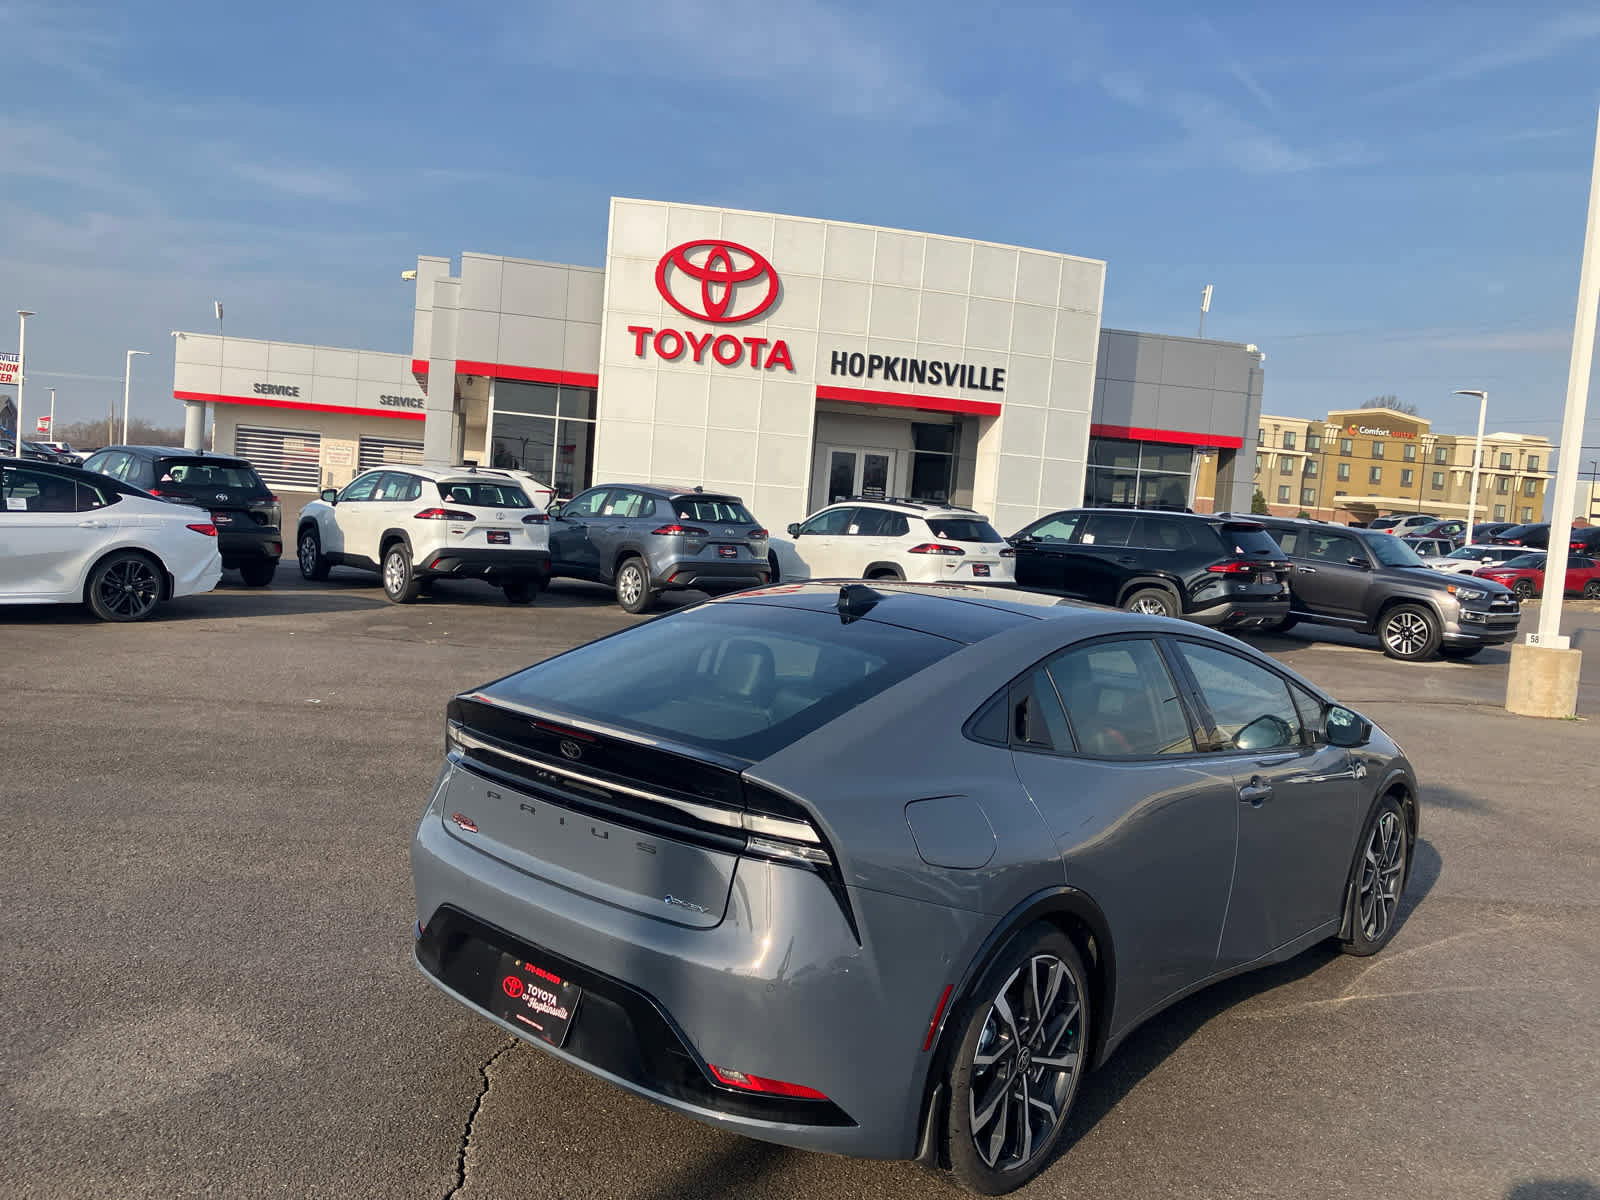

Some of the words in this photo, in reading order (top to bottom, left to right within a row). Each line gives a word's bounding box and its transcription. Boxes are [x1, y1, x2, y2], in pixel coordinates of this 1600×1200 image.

[627, 325, 793, 371] TOYOTA
[831, 350, 1007, 392] HOPKINSVILLE
[253, 382, 301, 398] SERVICE
[379, 394, 425, 409] SERVICE
[1359, 425, 1390, 436] Comfort
[487, 790, 657, 855] PRIUS
[527, 983, 557, 1007] TOYOTA
[527, 997, 569, 1020] Hopkinsville
